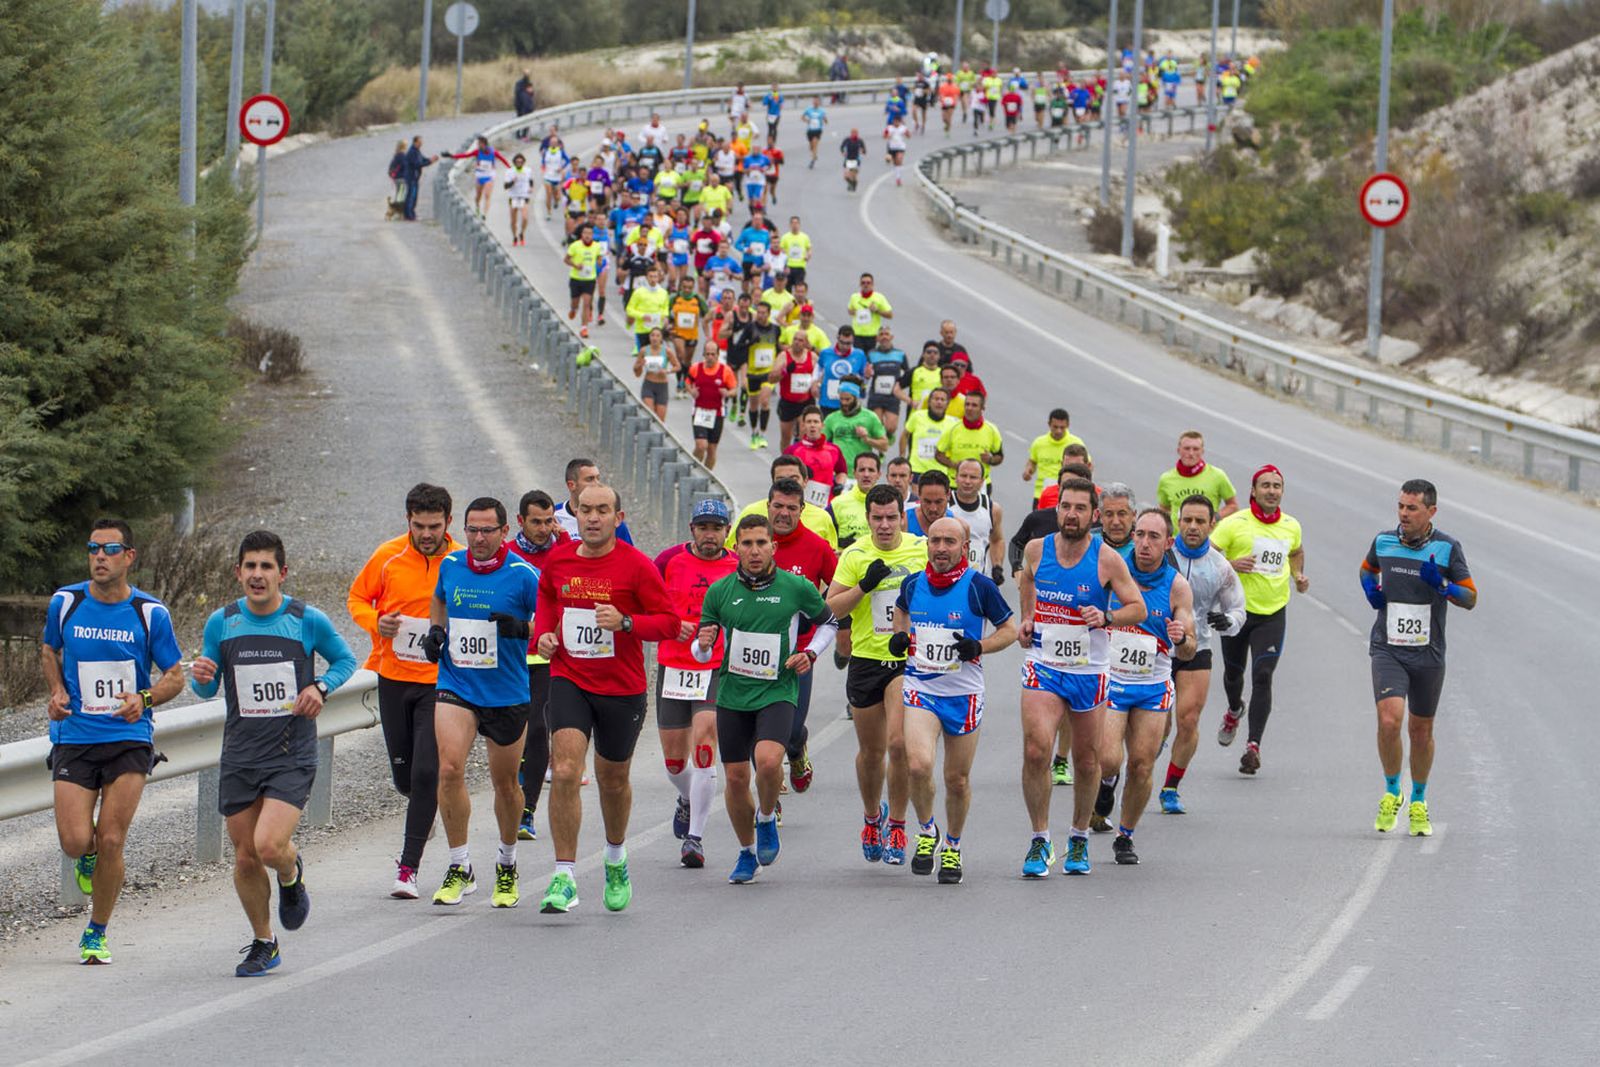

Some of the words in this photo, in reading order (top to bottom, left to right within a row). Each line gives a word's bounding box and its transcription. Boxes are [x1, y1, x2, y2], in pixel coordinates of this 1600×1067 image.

[1261, 550, 1283, 566] 838
[73, 625, 135, 643] TROTASIERRA
[1397, 618, 1422, 634] 523
[408, 632, 425, 649] 74
[576, 626, 603, 644] 702
[260, 650, 283, 658] LEGUA
[460, 637, 487, 655] 390
[926, 644, 953, 661] 870
[1055, 640, 1081, 657] 265
[742, 647, 770, 666] 590
[1120, 647, 1147, 666] 248
[679, 671, 701, 688] 121
[95, 679, 124, 698] 611
[253, 681, 286, 702] 506
